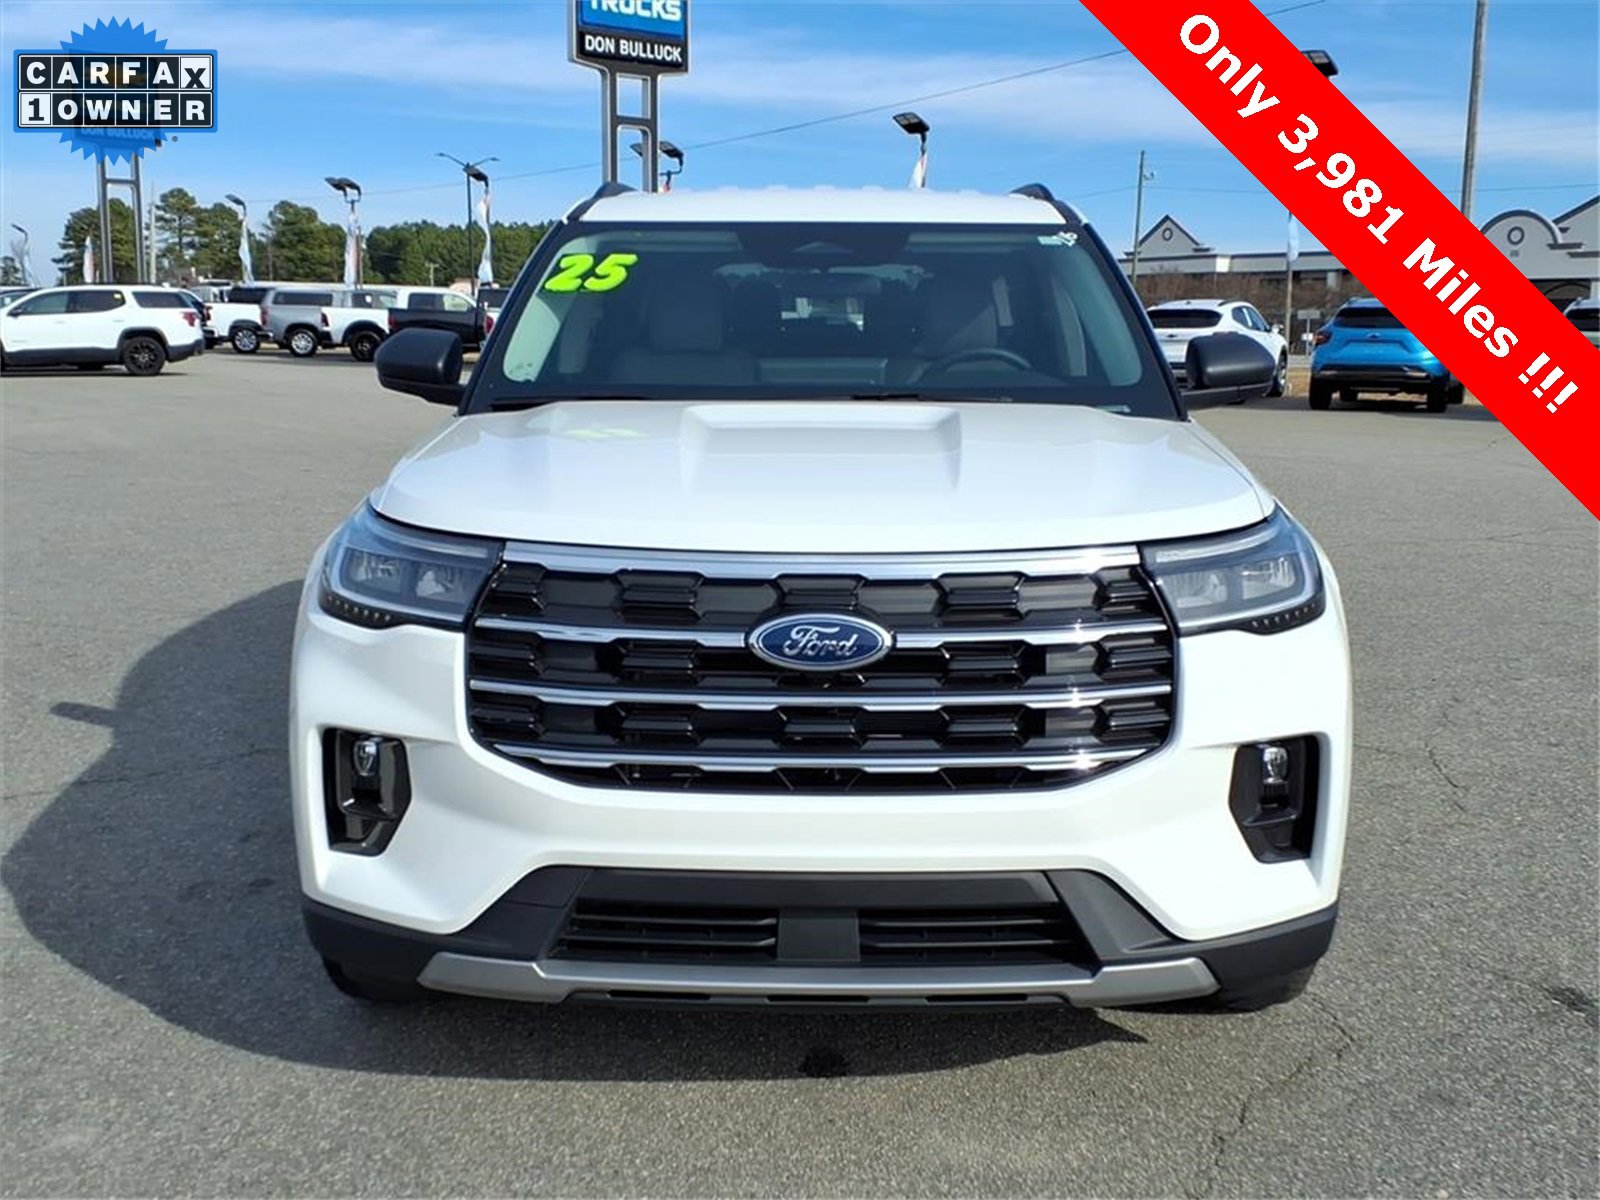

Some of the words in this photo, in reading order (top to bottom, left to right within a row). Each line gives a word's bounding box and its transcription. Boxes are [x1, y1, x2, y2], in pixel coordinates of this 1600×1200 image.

[584, 34, 616, 54] DON
[619, 38, 683, 63] BULLUCK
[543, 253, 639, 293] 25
[782, 624, 860, 657] Ford
